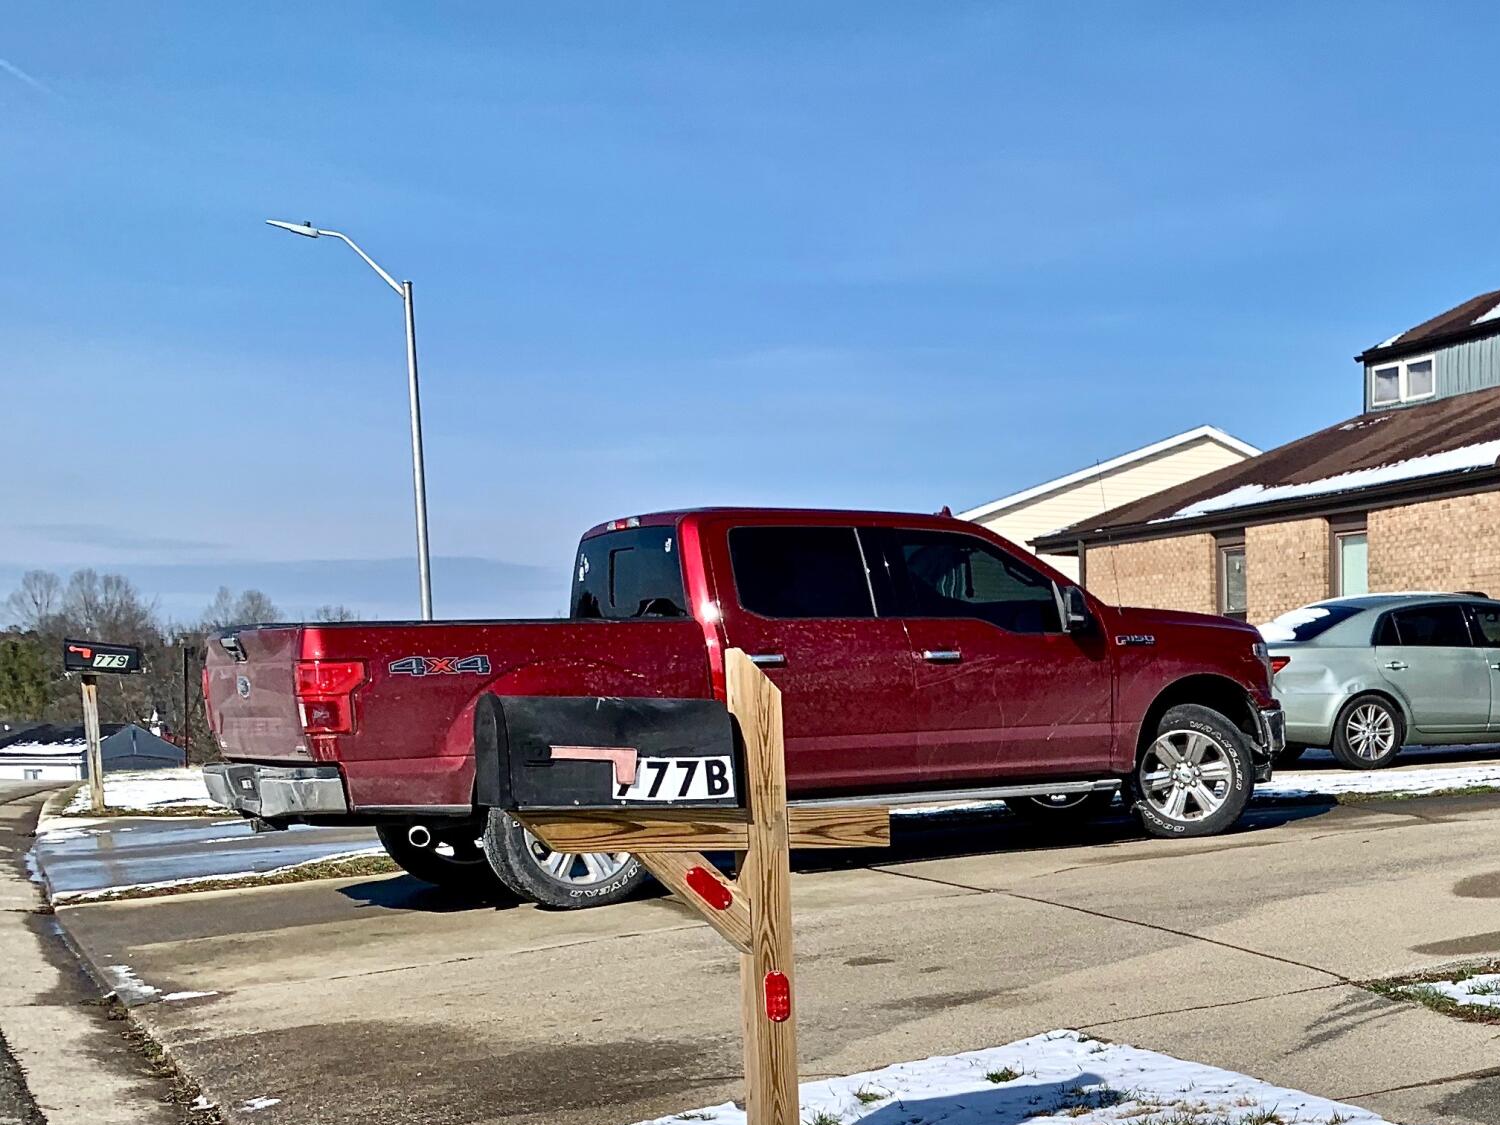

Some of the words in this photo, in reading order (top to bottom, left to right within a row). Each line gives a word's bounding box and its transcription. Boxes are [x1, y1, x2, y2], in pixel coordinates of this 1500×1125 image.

[96, 655, 127, 666] 779
[388, 655, 492, 676] 4X4
[1188, 720, 1243, 791] WRANGLER
